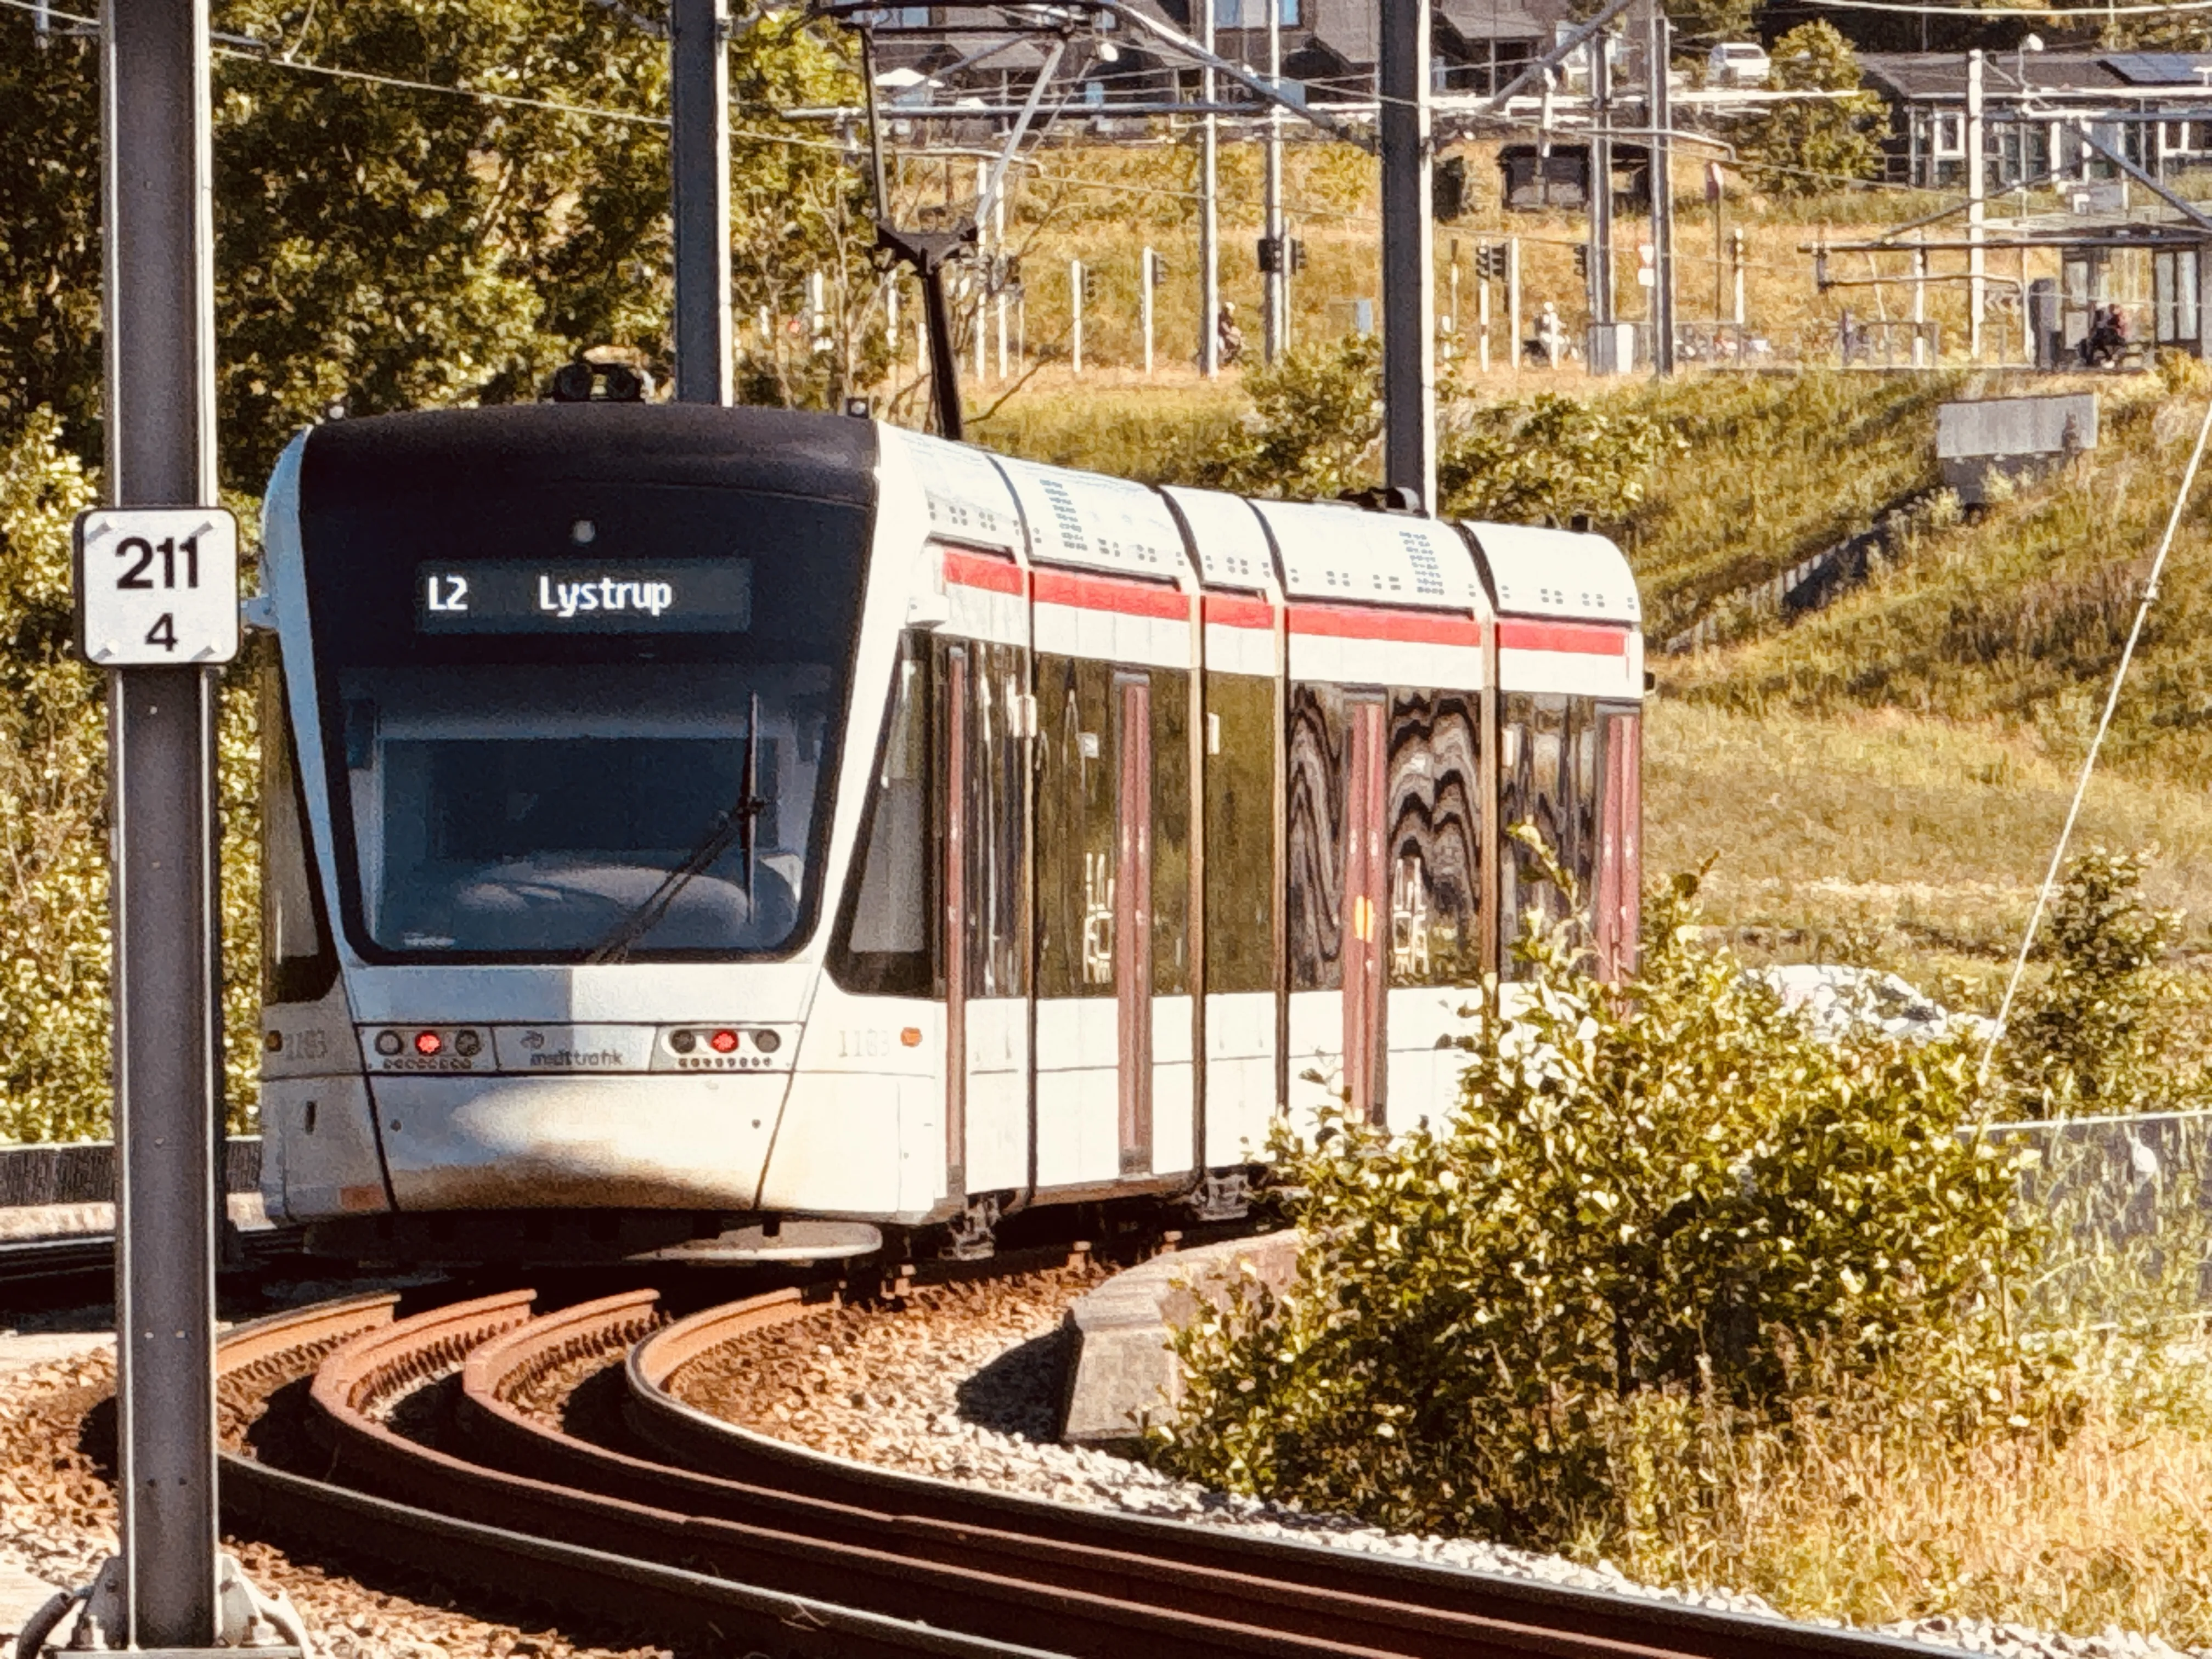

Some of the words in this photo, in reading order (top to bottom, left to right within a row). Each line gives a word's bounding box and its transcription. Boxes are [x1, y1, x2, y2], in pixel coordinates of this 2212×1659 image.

[115, 535, 199, 589] 211
[428, 575, 468, 611] L2
[540, 575, 673, 617] Lystrup
[144, 612, 179, 652] 4
